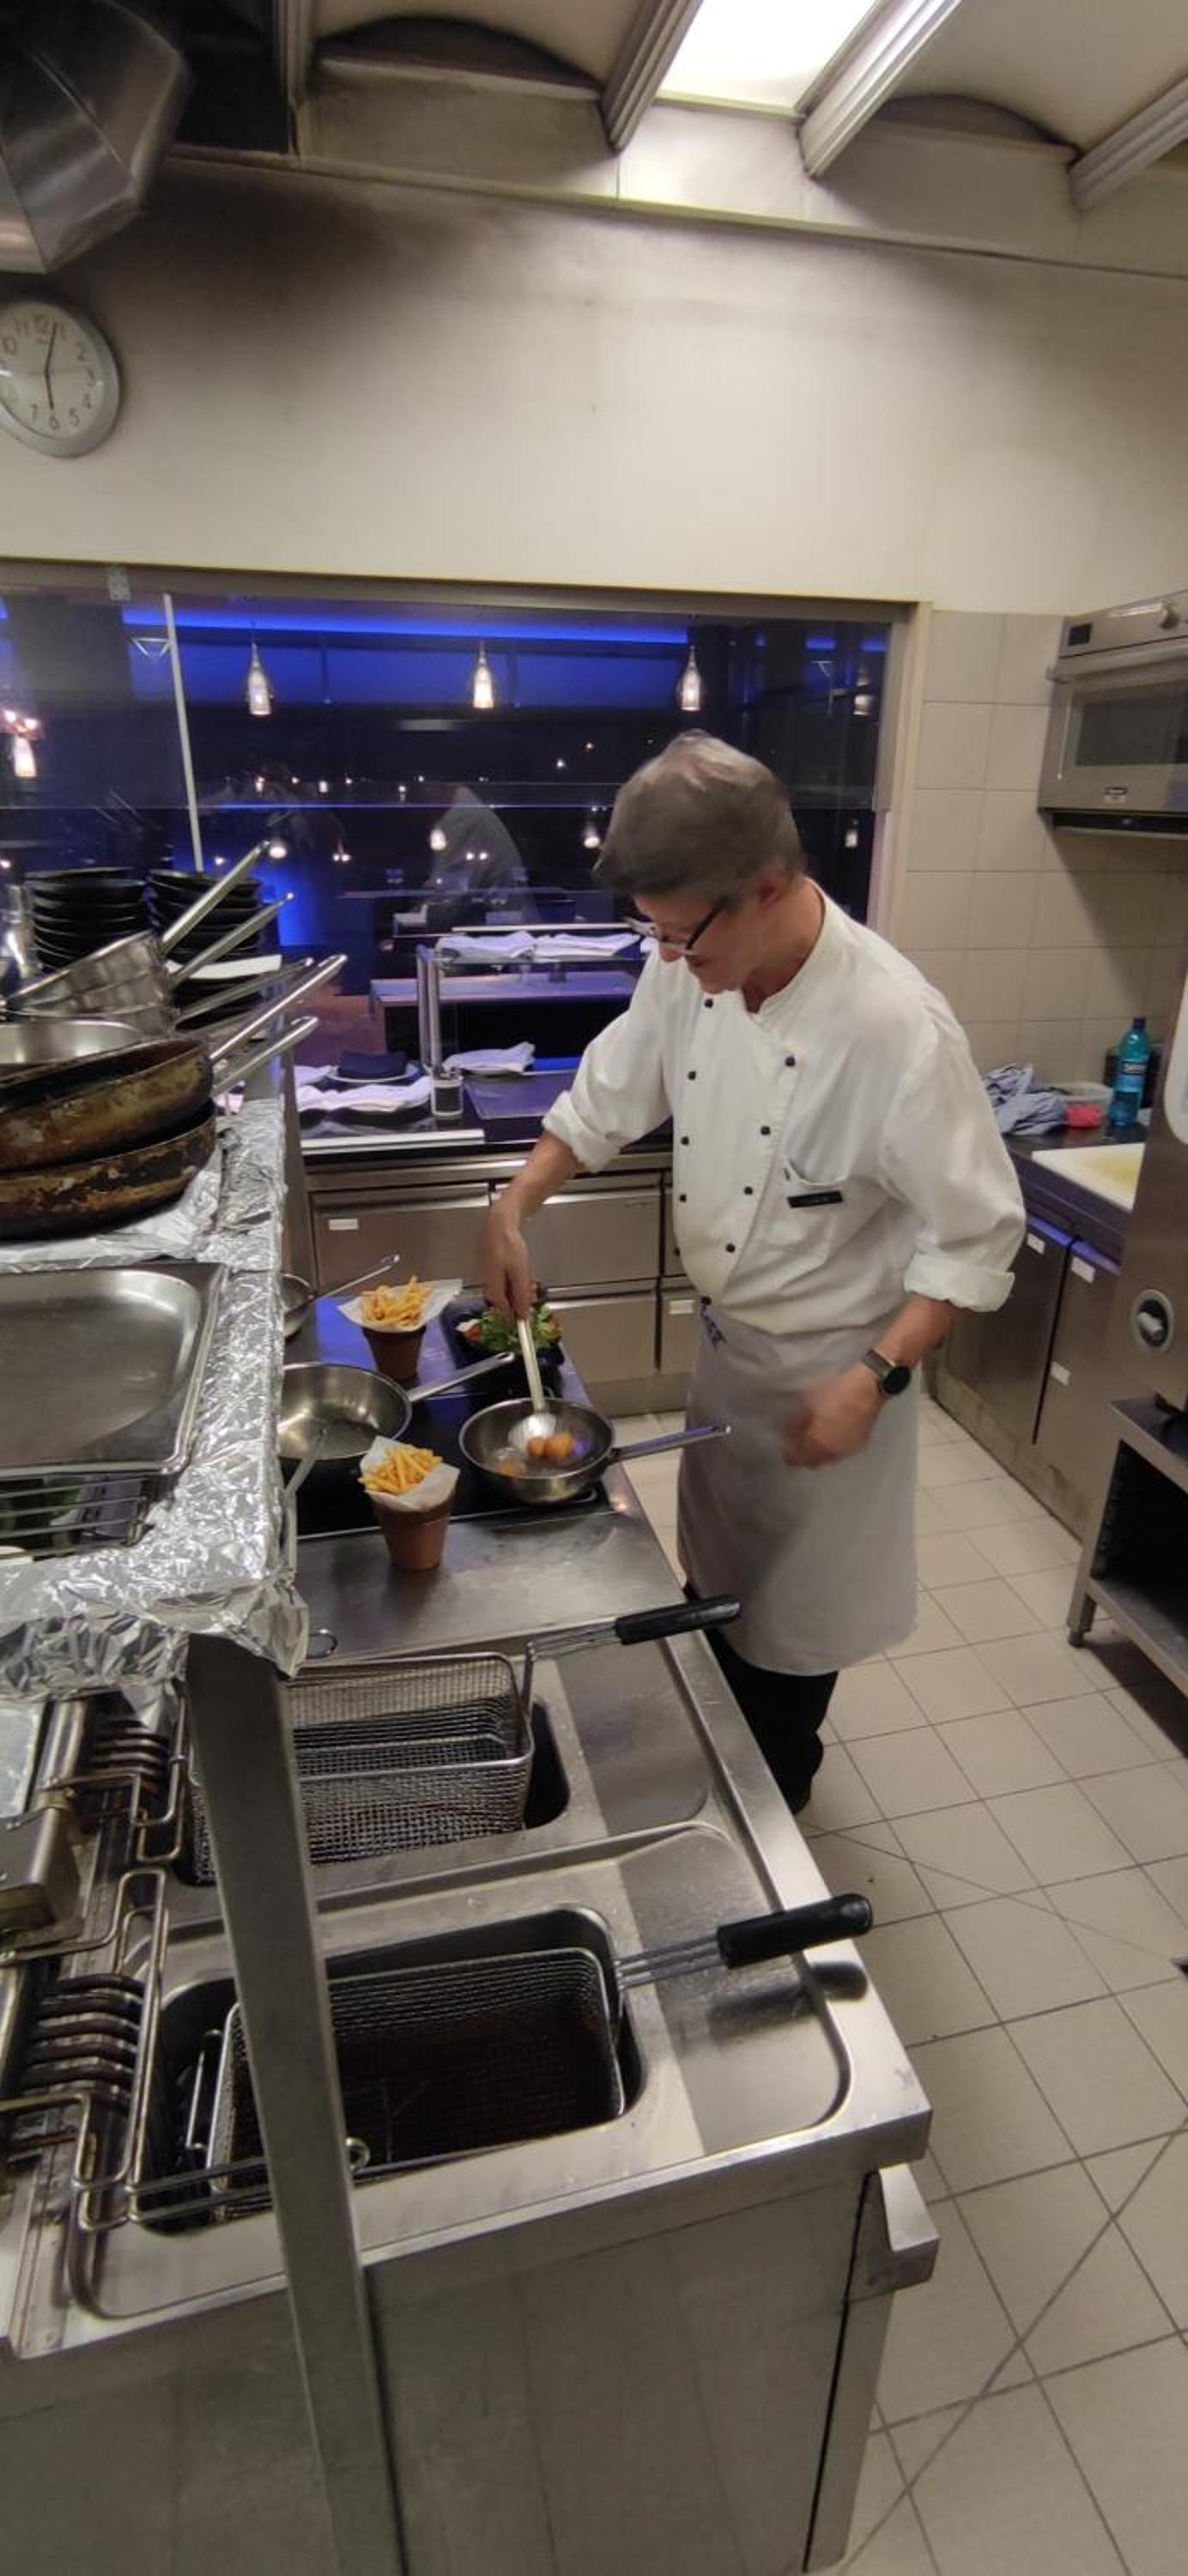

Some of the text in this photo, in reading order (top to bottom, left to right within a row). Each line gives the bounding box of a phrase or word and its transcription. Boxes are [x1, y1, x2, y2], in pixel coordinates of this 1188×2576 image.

[76, 342, 85, 361] 2
[29, 403, 39, 422] 7
[49, 414, 61, 430] 6
[69, 407, 81, 427] 5
